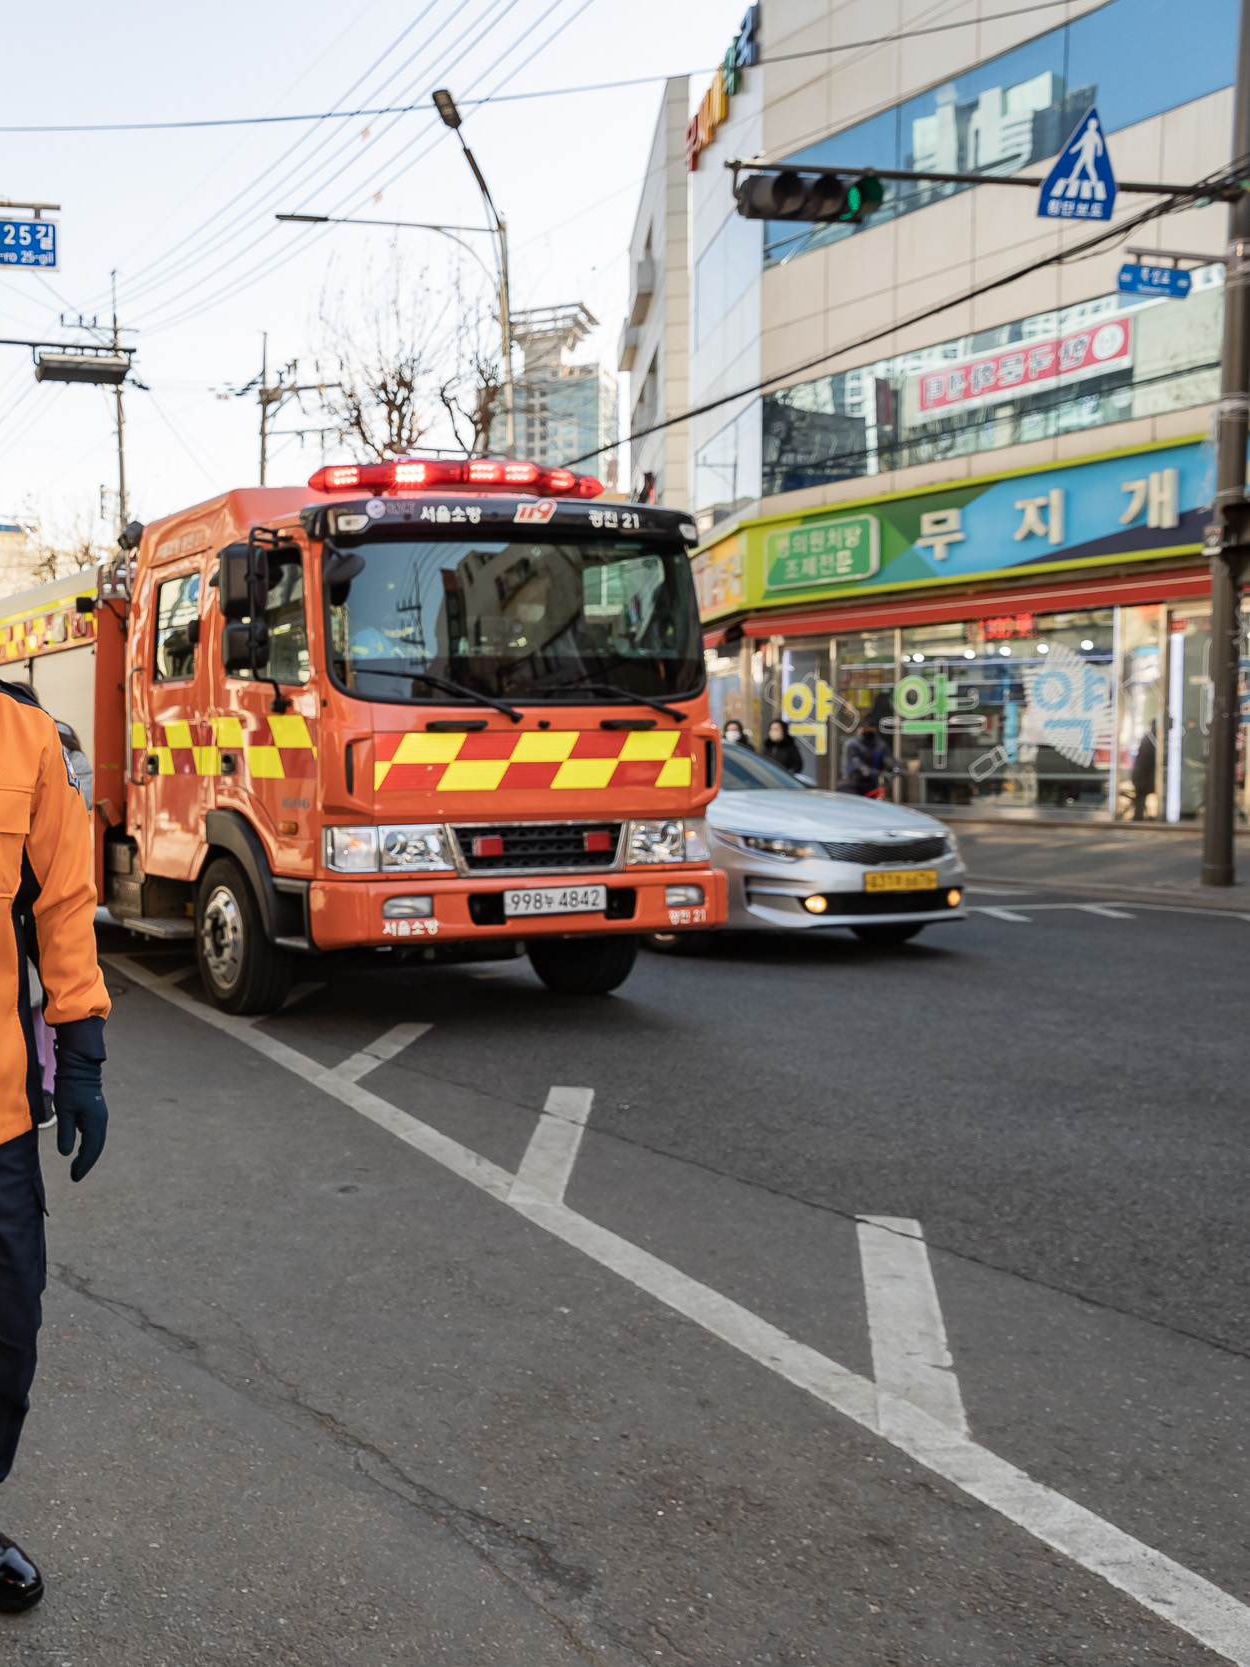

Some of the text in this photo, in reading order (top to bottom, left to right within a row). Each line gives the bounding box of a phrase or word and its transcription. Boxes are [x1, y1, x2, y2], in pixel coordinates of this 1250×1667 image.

[1047, 199, 1104, 217] 횡단보도
[20, 250, 54, 266] 25-gil
[420, 506, 482, 523] 서울소방
[517, 501, 556, 522] 119
[588, 510, 640, 528] 광진 21
[916, 468, 1180, 562] 무지개
[784, 550, 854, 579] 조제전문
[782, 680, 834, 756] 약
[894, 672, 958, 759] 약
[1032, 665, 1106, 752] 약
[558, 889, 600, 908] 4842
[692, 909, 706, 922] 21
[382, 919, 439, 936] 서울소방
